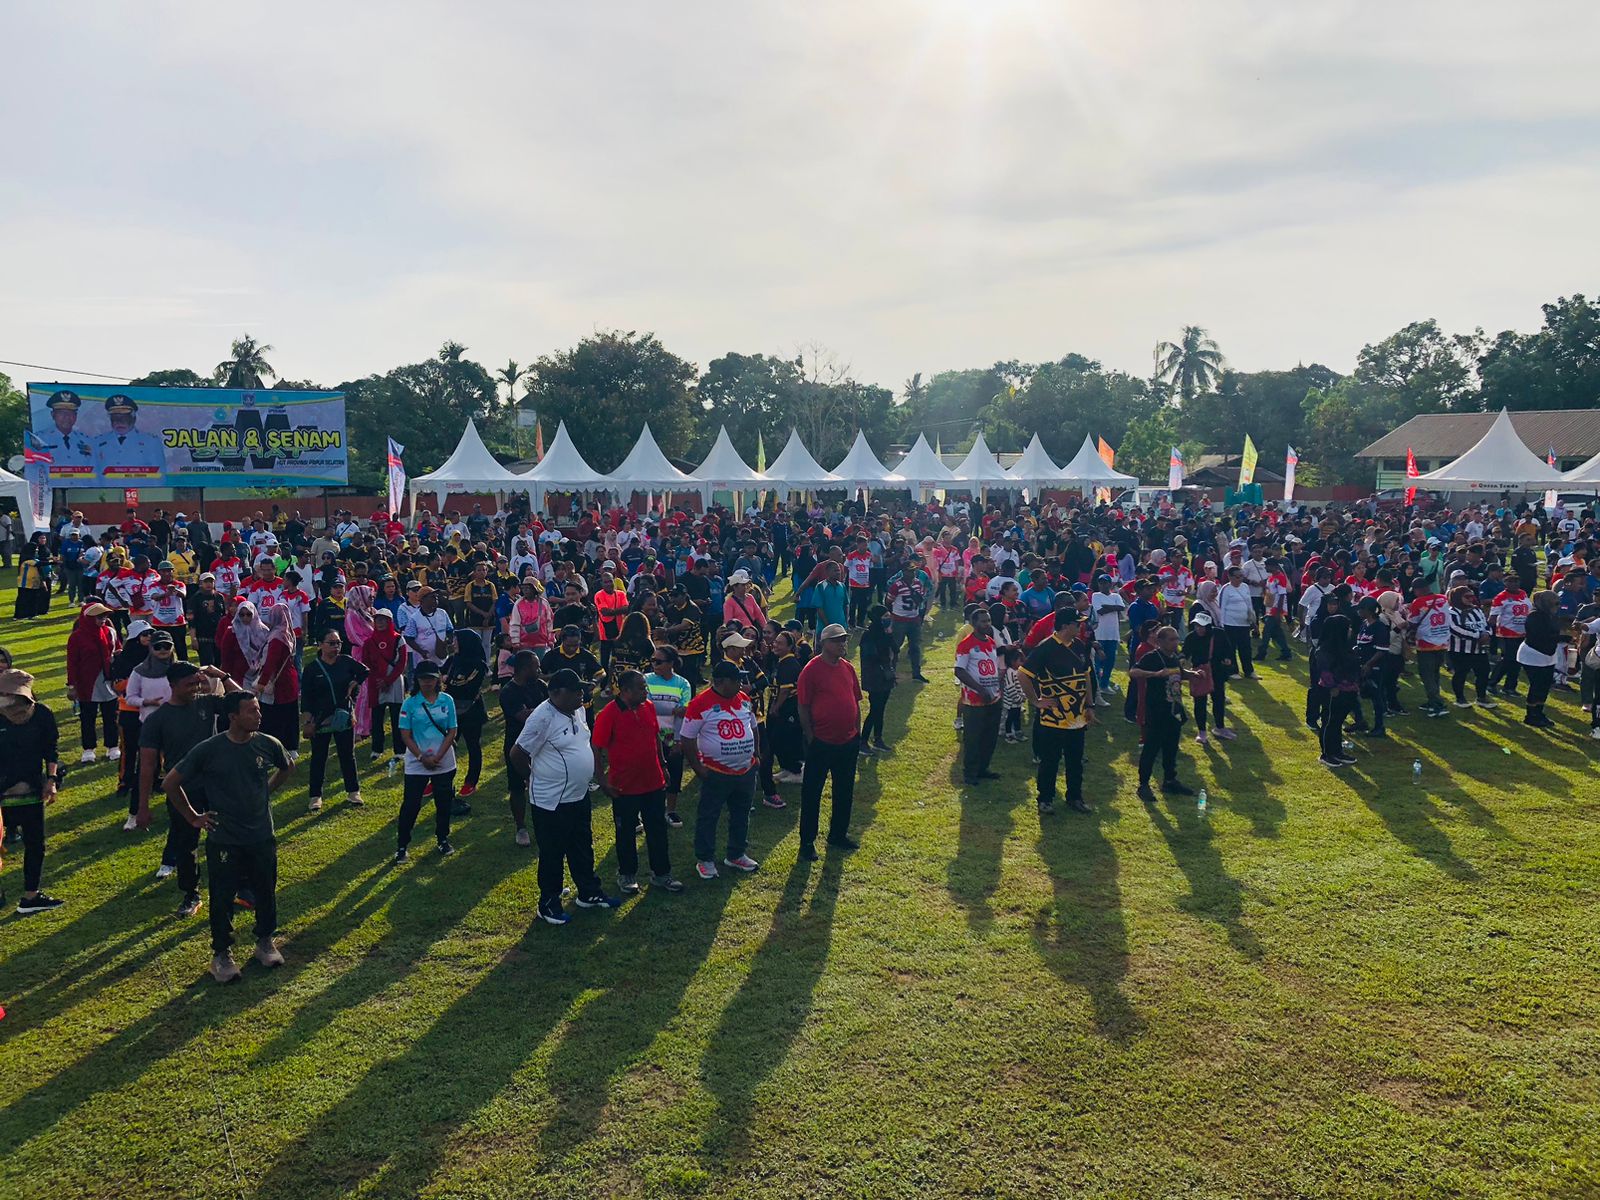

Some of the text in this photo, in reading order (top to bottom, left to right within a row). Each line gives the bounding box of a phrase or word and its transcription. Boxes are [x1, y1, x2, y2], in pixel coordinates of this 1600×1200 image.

[163, 428, 341, 449] JALAN & SENAM
[191, 447, 308, 459] SEHAT
[978, 659, 996, 676] 80
[717, 719, 746, 740] 80
